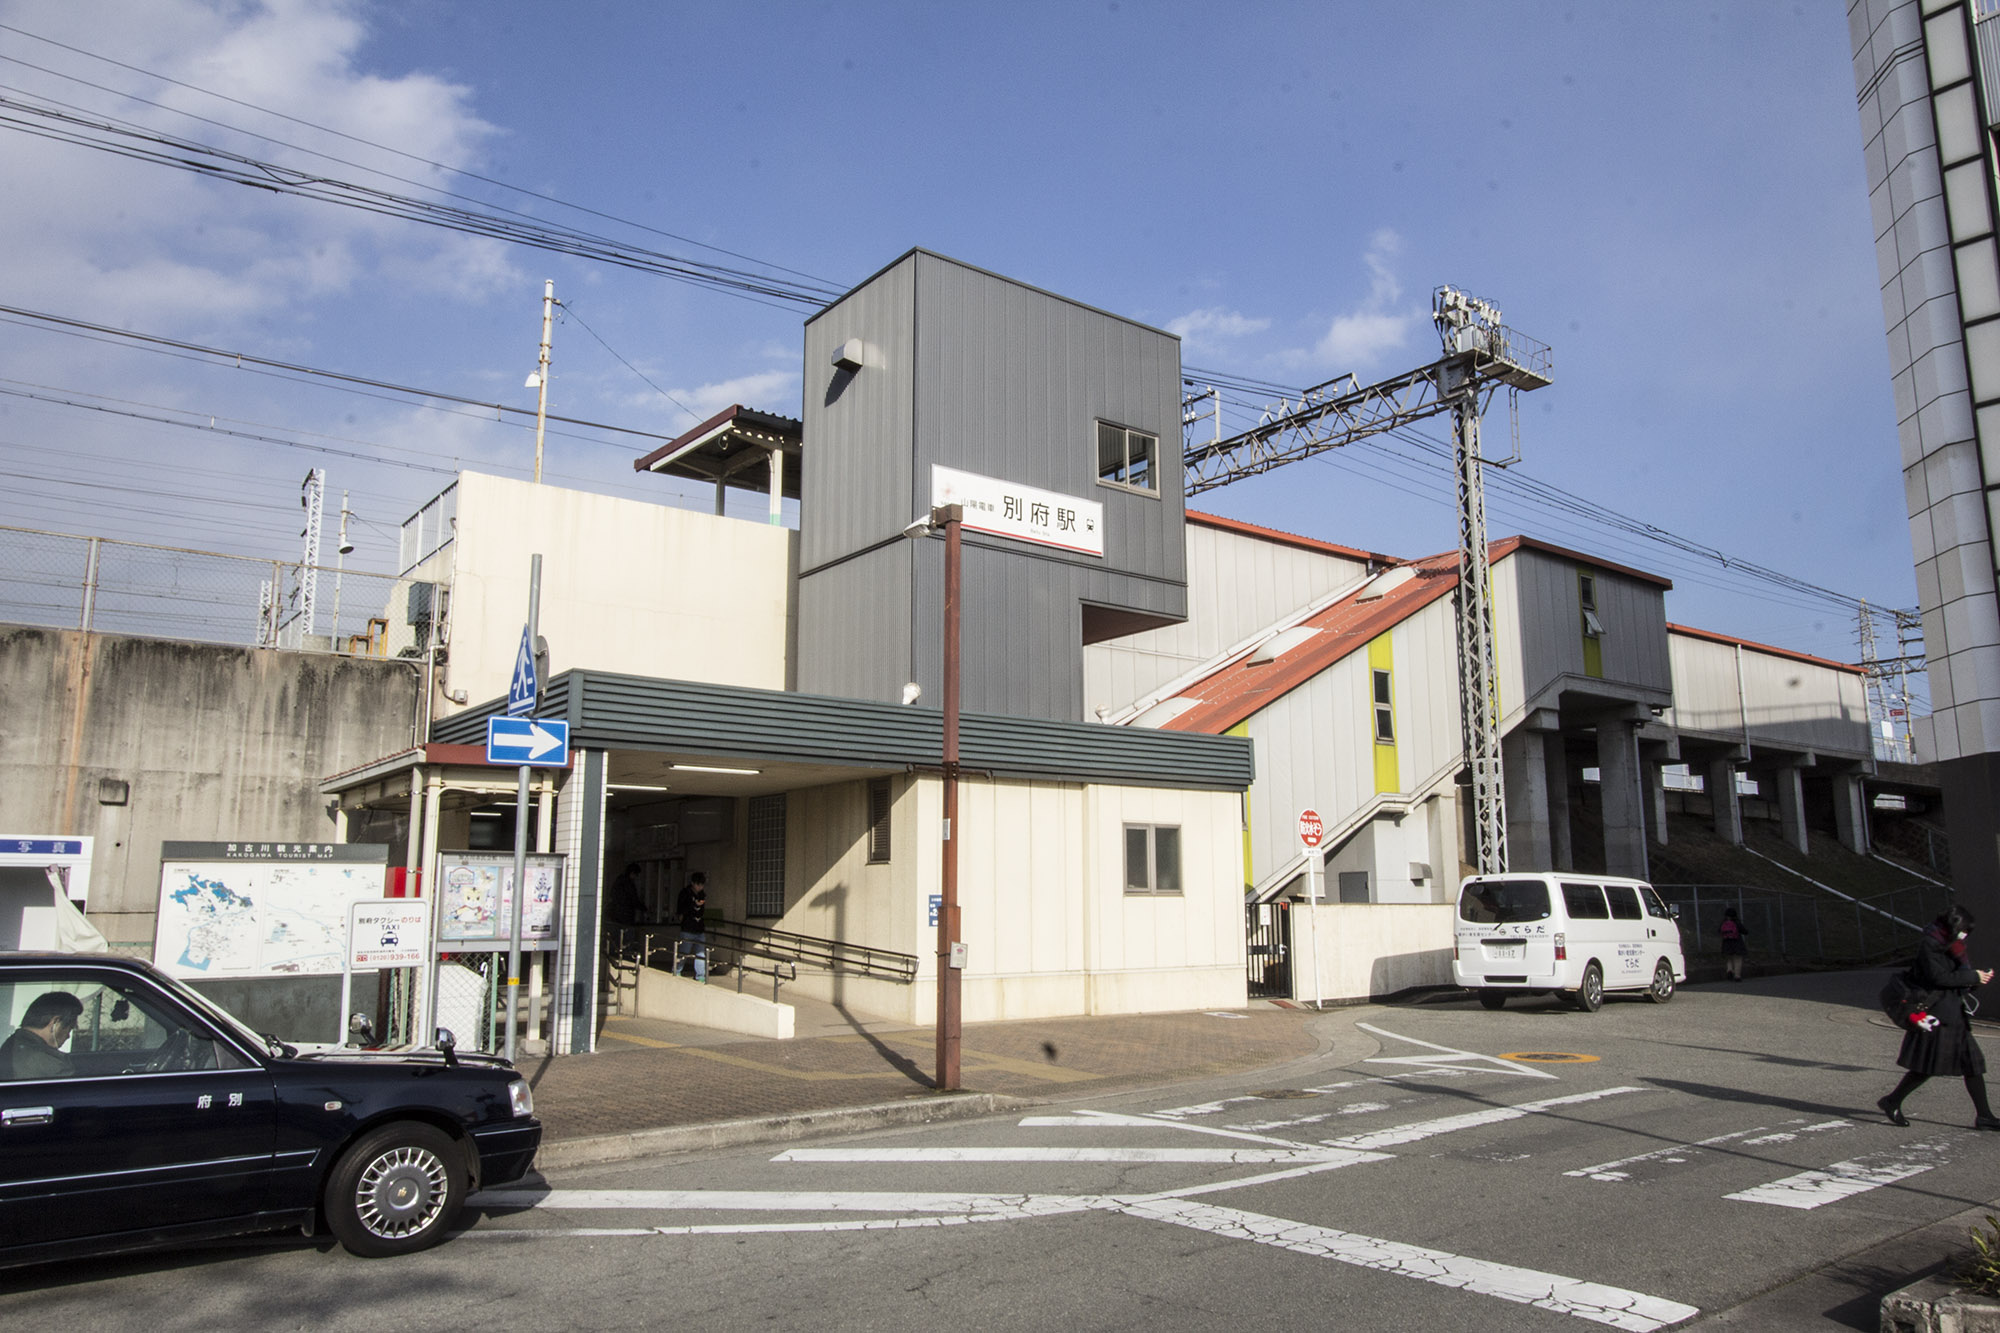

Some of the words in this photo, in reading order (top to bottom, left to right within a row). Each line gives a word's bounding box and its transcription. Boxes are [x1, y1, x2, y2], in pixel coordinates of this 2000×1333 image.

[1003, 495, 1076, 532] 別府駅
[18, 841, 66, 853] 写真
[227, 844, 334, 854] 加古川観光案内
[1512, 925, 1545, 934] てらだ
